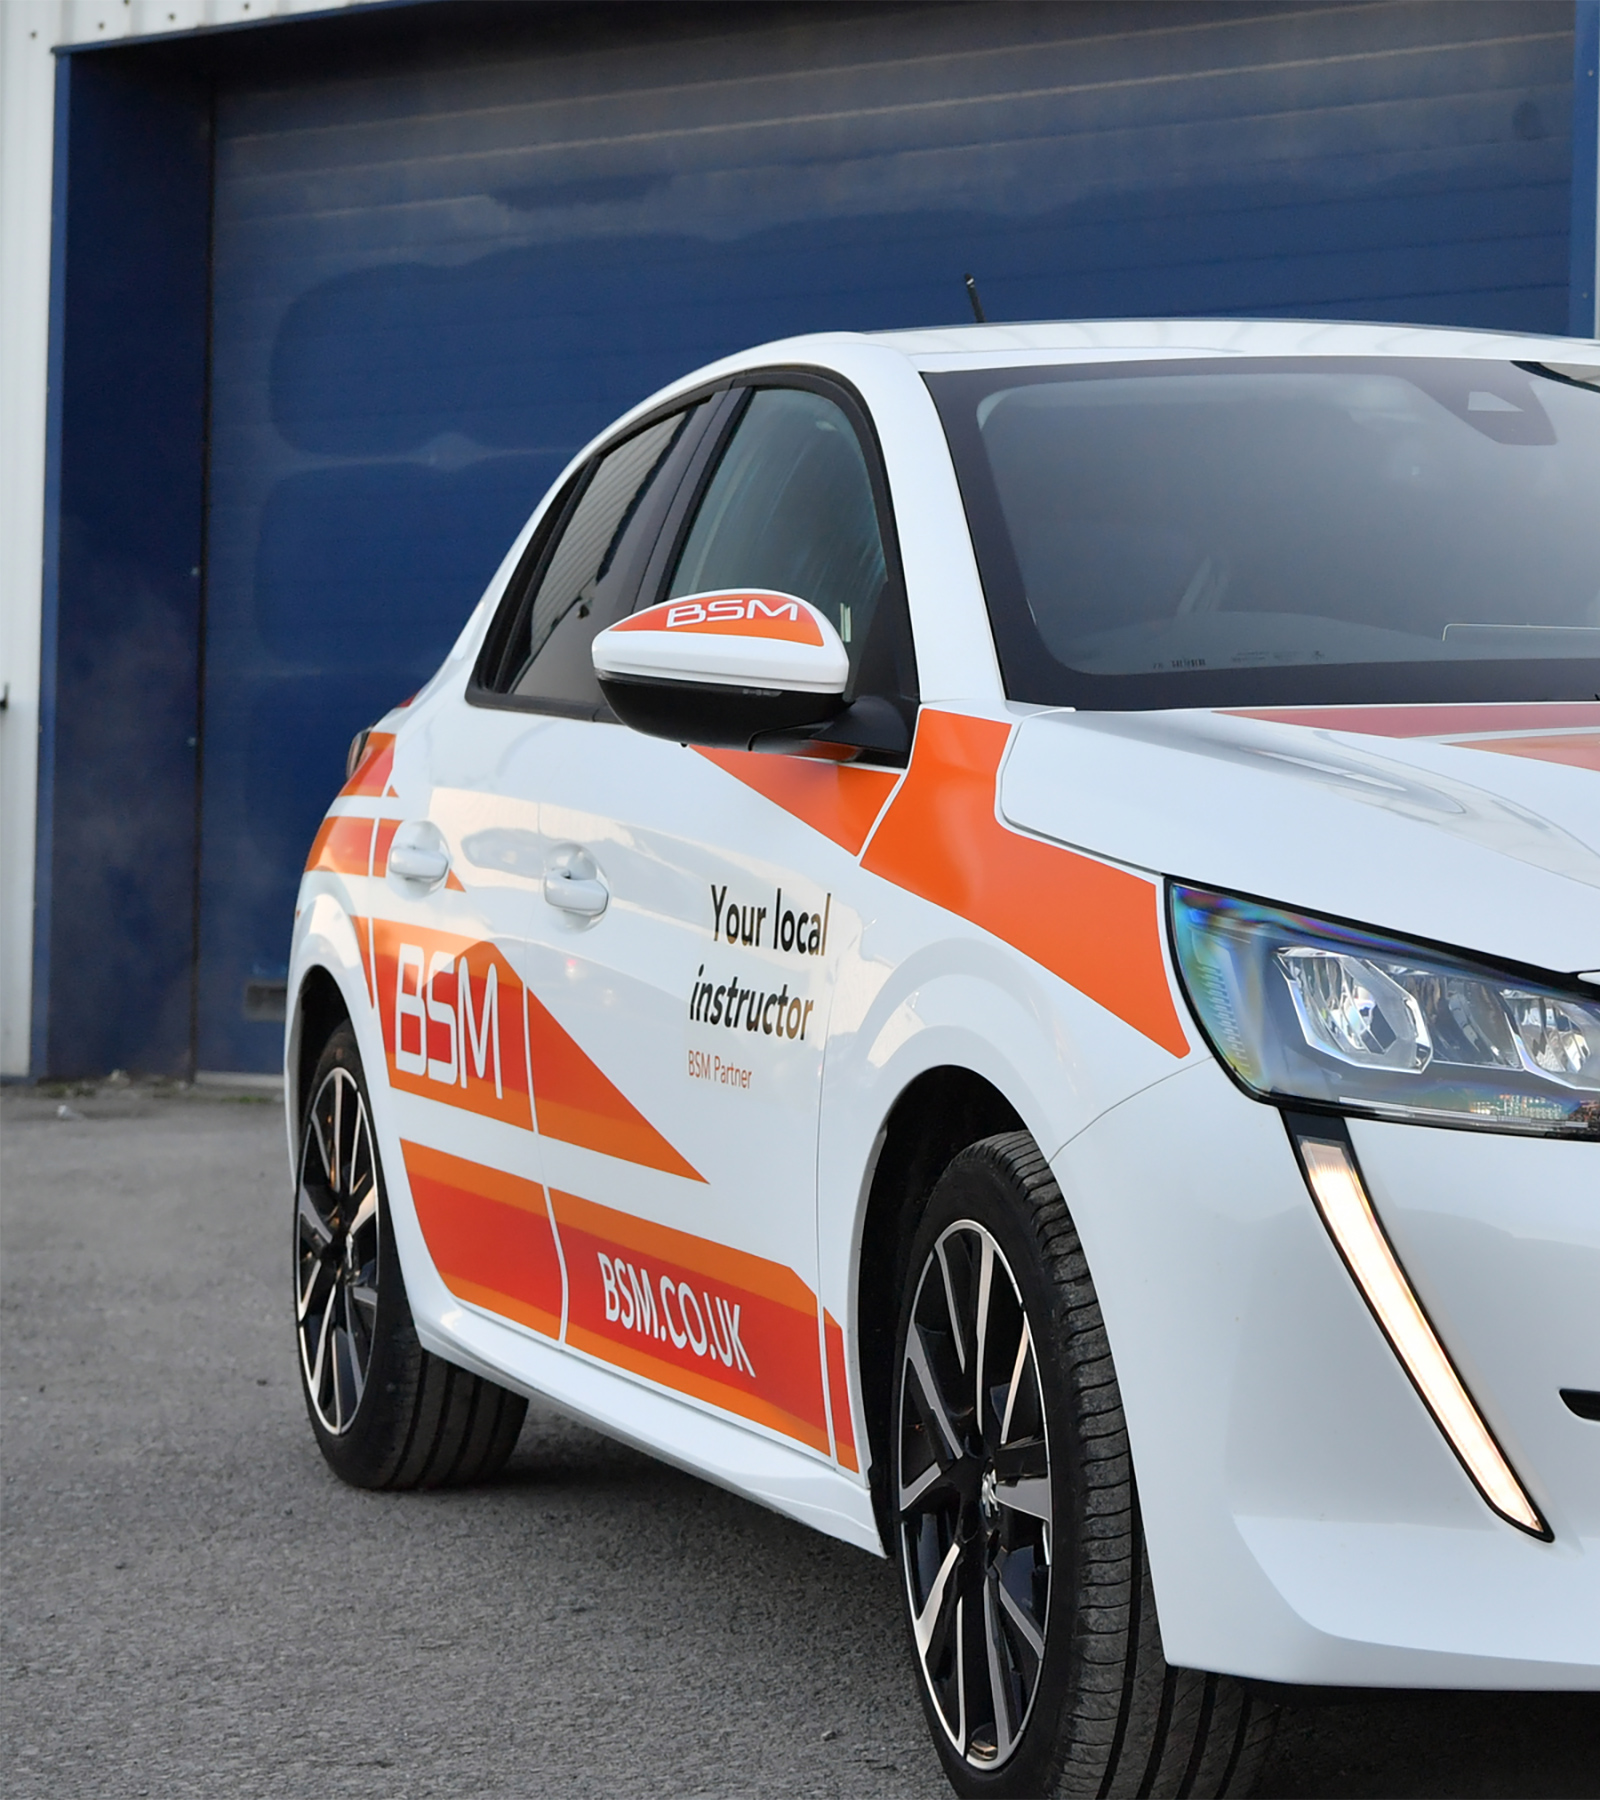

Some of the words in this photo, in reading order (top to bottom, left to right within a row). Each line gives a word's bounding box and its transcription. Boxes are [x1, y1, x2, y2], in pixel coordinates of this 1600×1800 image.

[666, 599, 799, 628] BSM
[710, 884, 766, 945] Your
[773, 887, 831, 956] local
[394, 942, 503, 1099] BSM
[689, 963, 815, 1041] instructor
[688, 1049, 711, 1080] BSM
[713, 1055, 753, 1090] Partner
[597, 1251, 757, 1378] BSM.CO.UK
